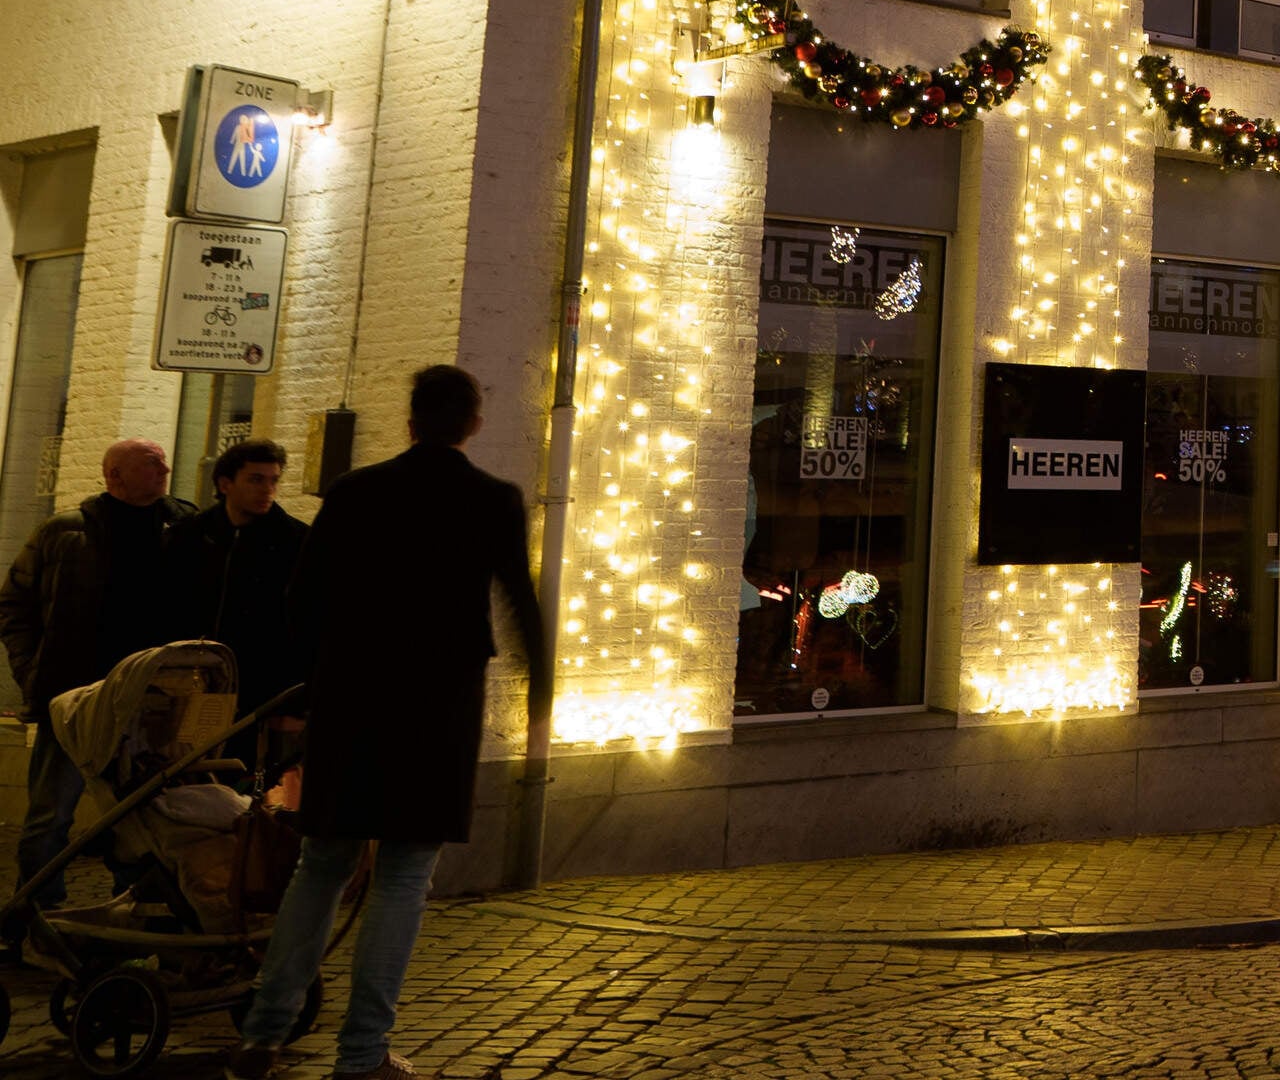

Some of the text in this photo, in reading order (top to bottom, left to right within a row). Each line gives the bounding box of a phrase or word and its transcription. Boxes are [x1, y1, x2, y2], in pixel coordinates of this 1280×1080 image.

[235, 80, 274, 101] ZONE
[199, 230, 262, 244] toegestaan
[1151, 276, 1280, 321] EEREN
[1150, 314, 1279, 336] annenmode
[804, 417, 866, 431] HEEREN
[803, 431, 865, 451] SALE!
[1179, 429, 1228, 442] HEEREN
[1178, 441, 1228, 460] SALE!
[802, 451, 863, 476] 50%
[1011, 451, 1121, 478] HEEREN
[1178, 459, 1227, 482] 50%
